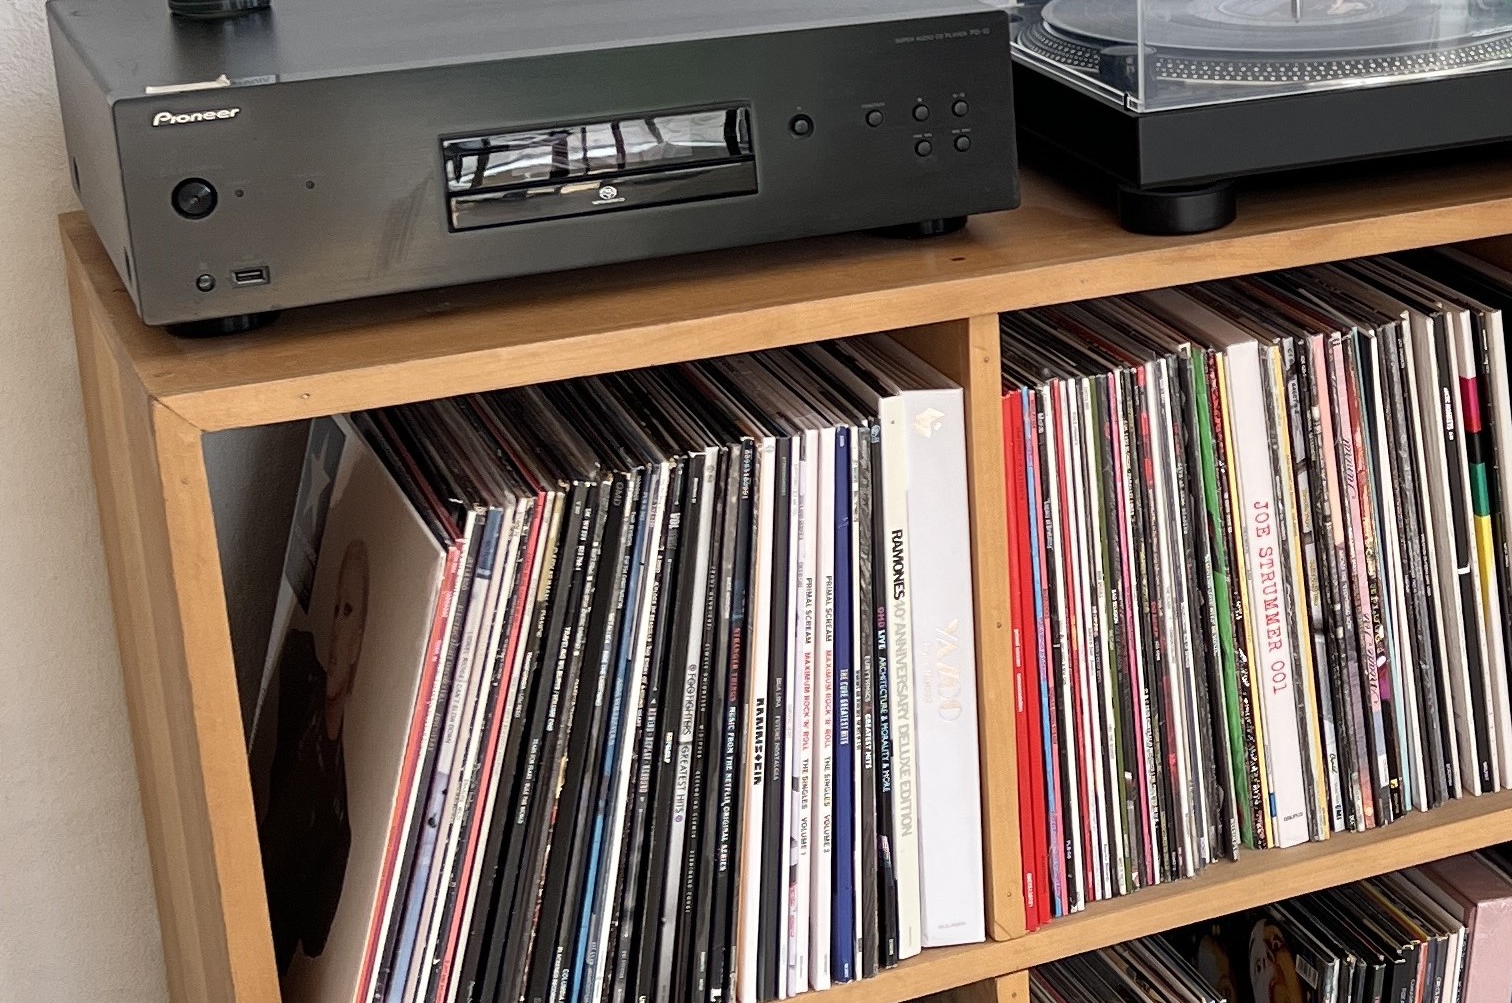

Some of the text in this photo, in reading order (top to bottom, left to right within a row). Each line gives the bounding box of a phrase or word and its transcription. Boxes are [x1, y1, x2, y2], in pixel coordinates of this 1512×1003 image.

[152, 107, 241, 127] Pioneer
[612, 481, 625, 507] OMD
[804, 577, 813, 607] PRIMAL
[824, 575, 833, 606] PRIMAL
[1253, 501, 1287, 695] JOE STRUMMER 001
[804, 610, 813, 644] SCREAM
[824, 608, 833, 642] SCREAM
[877, 630, 886, 650] LIVE
[731, 627, 741, 670] STRANGER
[803, 652, 812, 693] MAXIMUM
[824, 650, 832, 691] MAXIMUM
[879, 657, 889, 715] ARCHITECTURE
[891, 529, 914, 837] RAMONES ANNIVERSARY DELUXE EDITION
[727, 706, 736, 729] MUSIC
[802, 695, 811, 717] ROCK
[824, 693, 832, 715] ROCK
[726, 732, 736, 754] FROM
[753, 698, 765, 785] RAMMSTEIN
[801, 730, 809, 751] ROLL
[824, 728, 832, 749] ROLL
[864, 713, 872, 750] GREATEST
[881, 723, 890, 761] MORALITY
[675, 746, 691, 791] GREATEST
[725, 756, 734, 770] THE
[801, 759, 809, 774] THE
[823, 756, 831, 772] THE
[864, 751, 872, 769] HITS
[800, 776, 809, 810] SINGLES
[823, 773, 831, 807] SINGLES
[881, 770, 891, 793] MORE
[675, 794, 686, 814] HITS
[721, 805, 731, 841] ORIGINAL
[800, 818, 808, 850] VOLUME
[823, 815, 831, 846] VOLUME
